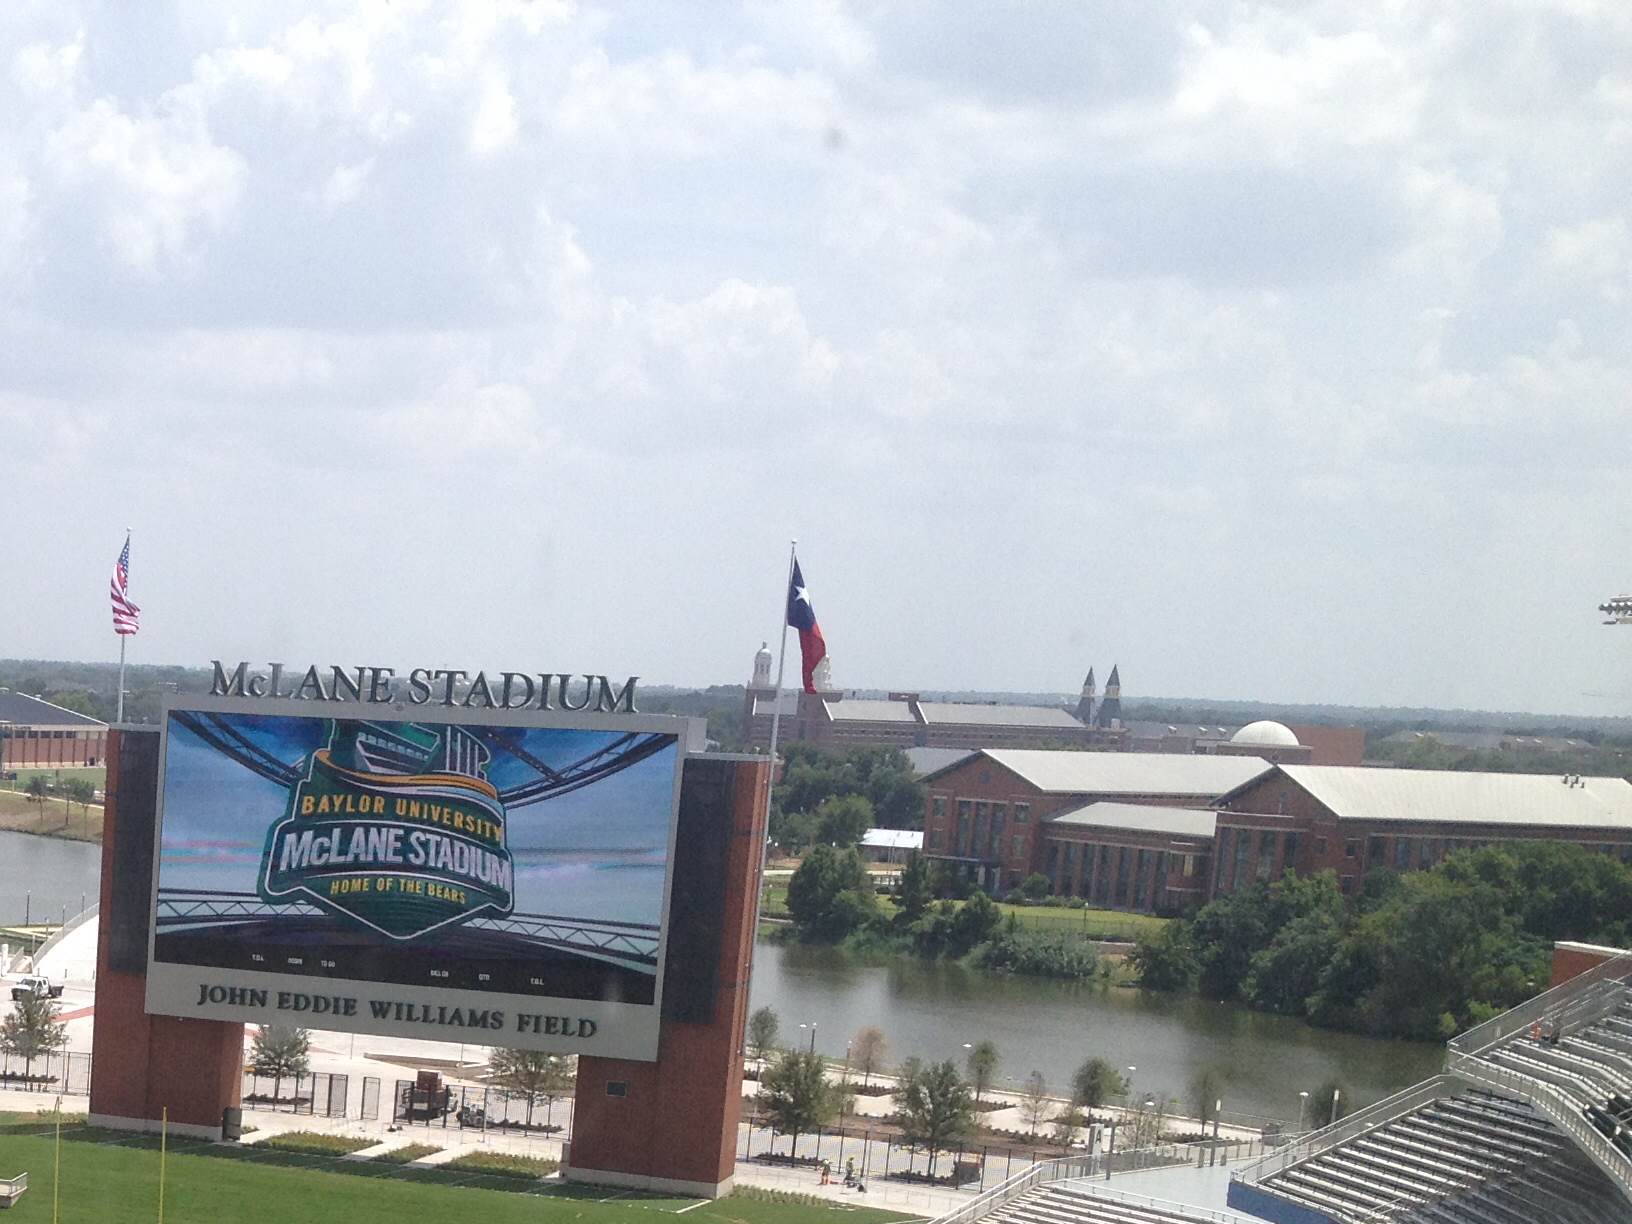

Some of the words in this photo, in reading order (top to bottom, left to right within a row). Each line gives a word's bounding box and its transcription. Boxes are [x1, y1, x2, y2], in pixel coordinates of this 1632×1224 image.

[209, 660, 395, 704] McLANE
[408, 668, 640, 713] STADIUM
[301, 795, 385, 815] BAYLOR
[396, 798, 502, 841] UNIVERSITY
[279, 827, 405, 871] McLANE
[409, 831, 511, 891] STADIUM
[330, 878, 369, 895] HOME
[376, 878, 393, 890] OF
[400, 879, 422, 893] THE
[428, 883, 466, 904] BEARS
[197, 984, 268, 1008] JOHN
[277, 992, 358, 1016] EDDIE
[368, 1001, 504, 1030] WILLIAMS
[517, 1013, 597, 1038] FIELD
